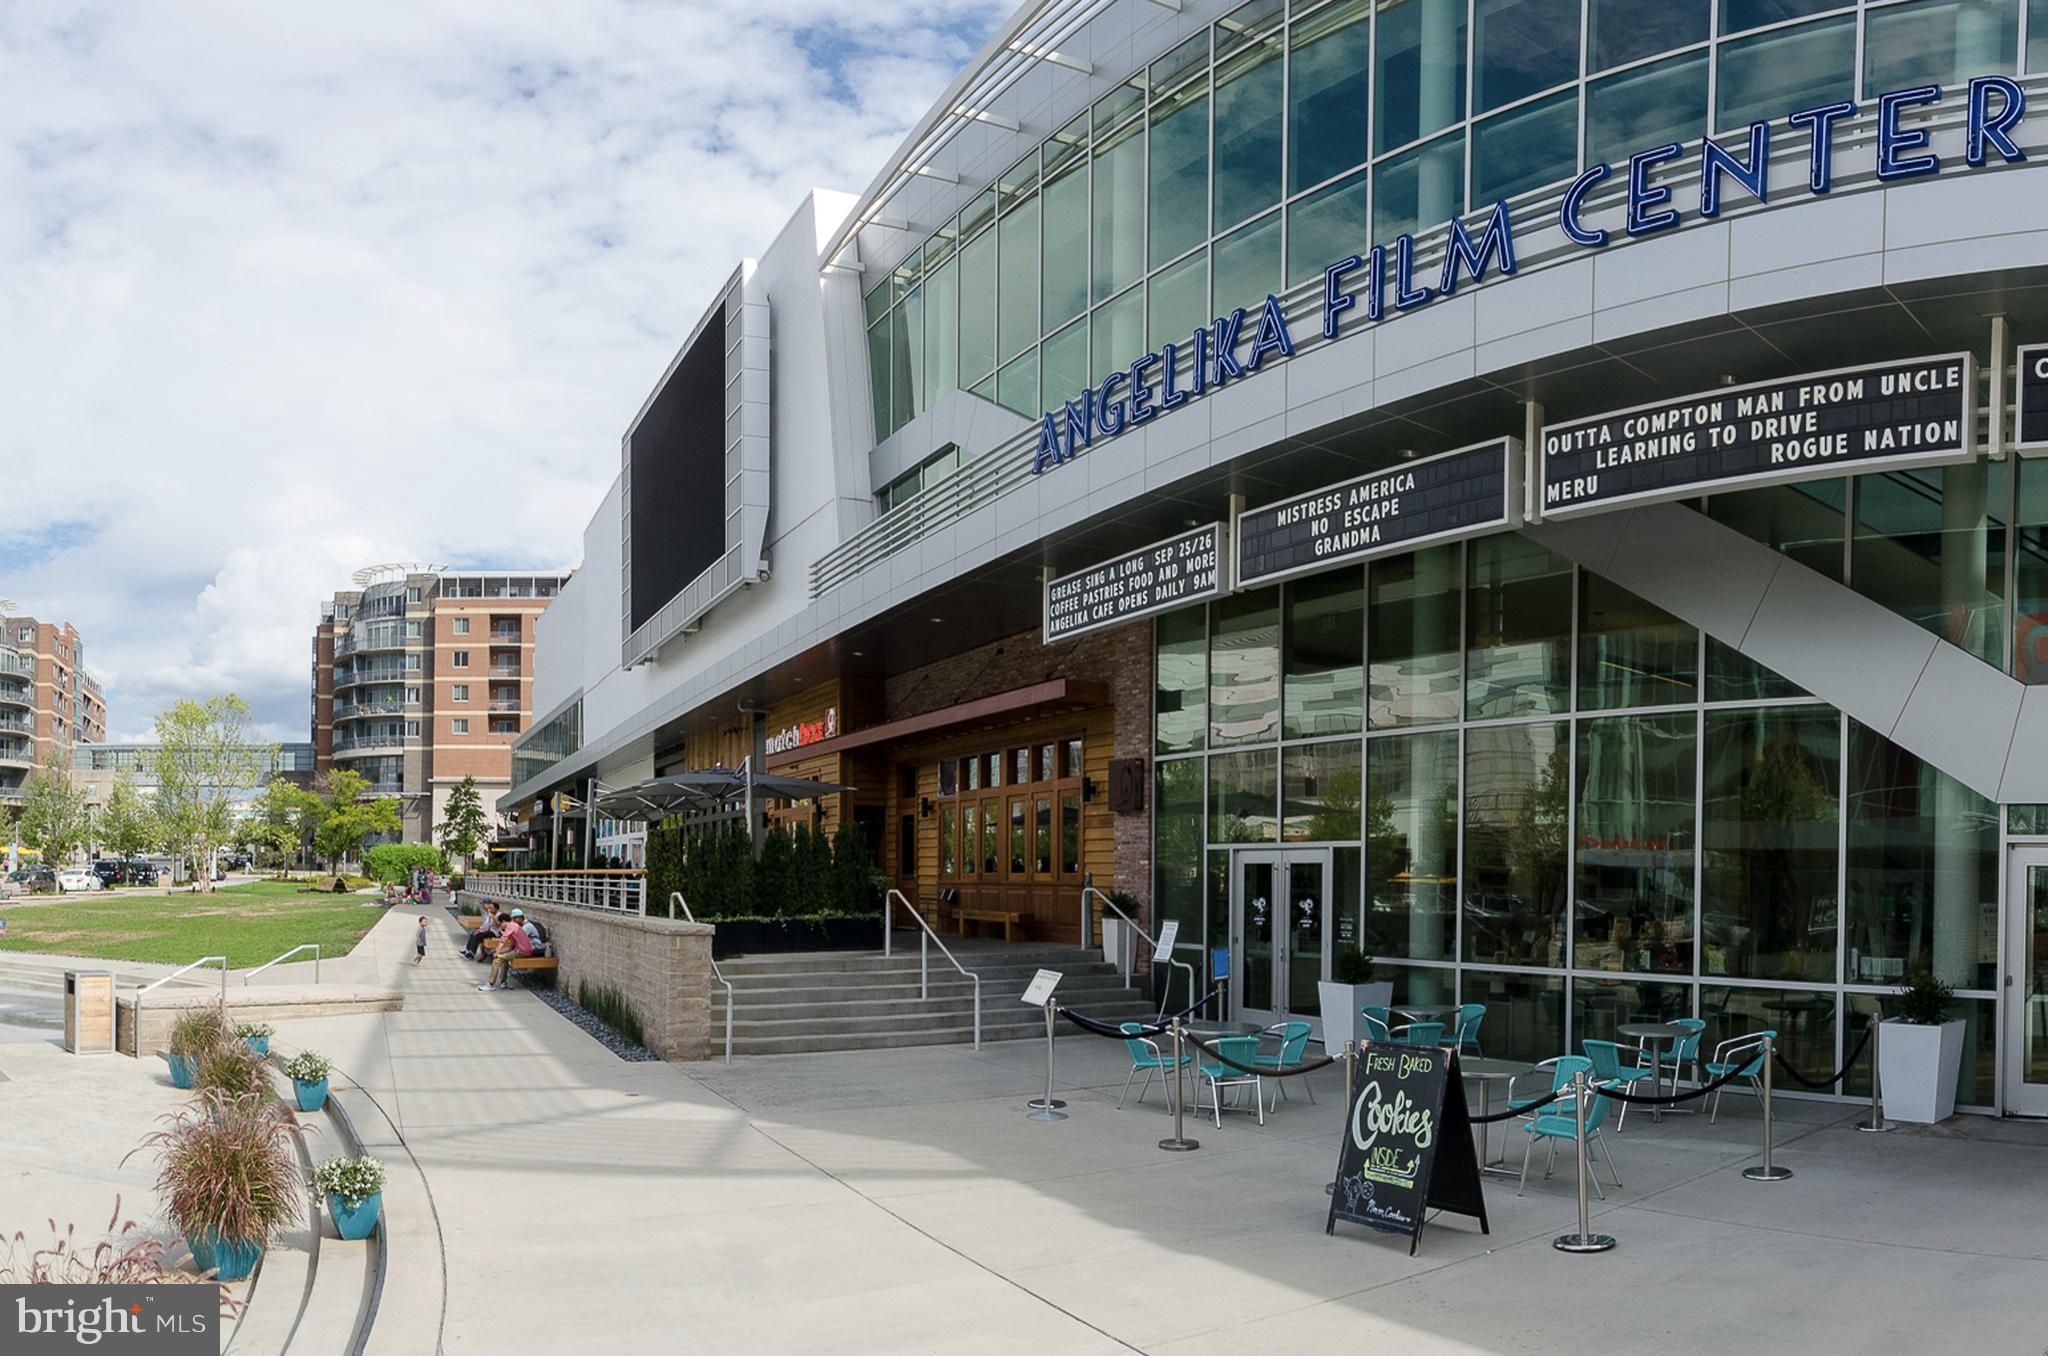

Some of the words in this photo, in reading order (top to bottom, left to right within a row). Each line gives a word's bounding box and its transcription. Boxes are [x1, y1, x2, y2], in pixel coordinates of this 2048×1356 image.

[1032, 294, 1295, 475] ANGELIKA
[1323, 201, 1516, 339] FILM
[1560, 75, 2027, 247] CENTER
[1547, 425, 1611, 456] OUTTA
[1623, 402, 1722, 439] COMPTON
[1737, 392, 1783, 417] MAN
[1799, 378, 1864, 408] FROM
[1880, 366, 1960, 396] UNCLE
[1596, 431, 1696, 469] LEARNING
[1709, 425, 1736, 448] TO
[1751, 410, 1818, 441] DRIVE
[1547, 475, 1598, 503] MERU
[1771, 433, 1848, 464] ROGUE
[1864, 420, 1958, 451] NATION
[1277, 493, 1341, 527] MISTRESS
[1349, 472, 1415, 506] AMERICA
[1311, 518, 1328, 537] NO
[1344, 498, 1399, 528] ESCAPE
[1051, 580, 1081, 601] GREASE
[1086, 571, 1105, 590] SING
[1109, 568, 1116, 581] A
[1120, 557, 1144, 577] LONG
[1155, 547, 1173, 565] SEP
[1179, 534, 1212, 558] 25/26
[1315, 525, 1380, 556] GRANDMA
[1050, 596, 1079, 617] COFFEE
[1083, 581, 1124, 607] PASTRIES
[1129, 572, 1153, 592] FOOD
[1159, 564, 1178, 582] AND
[1187, 552, 1215, 573] MORE
[1050, 610, 1088, 633] ANGELIKA
[1092, 601, 1114, 620] CAFE
[1119, 591, 1148, 611] OPENS
[1155, 579, 1185, 601] DAILY
[1193, 569, 1216, 590] 9AM
[1352, 1080, 1433, 1150] Cookies
